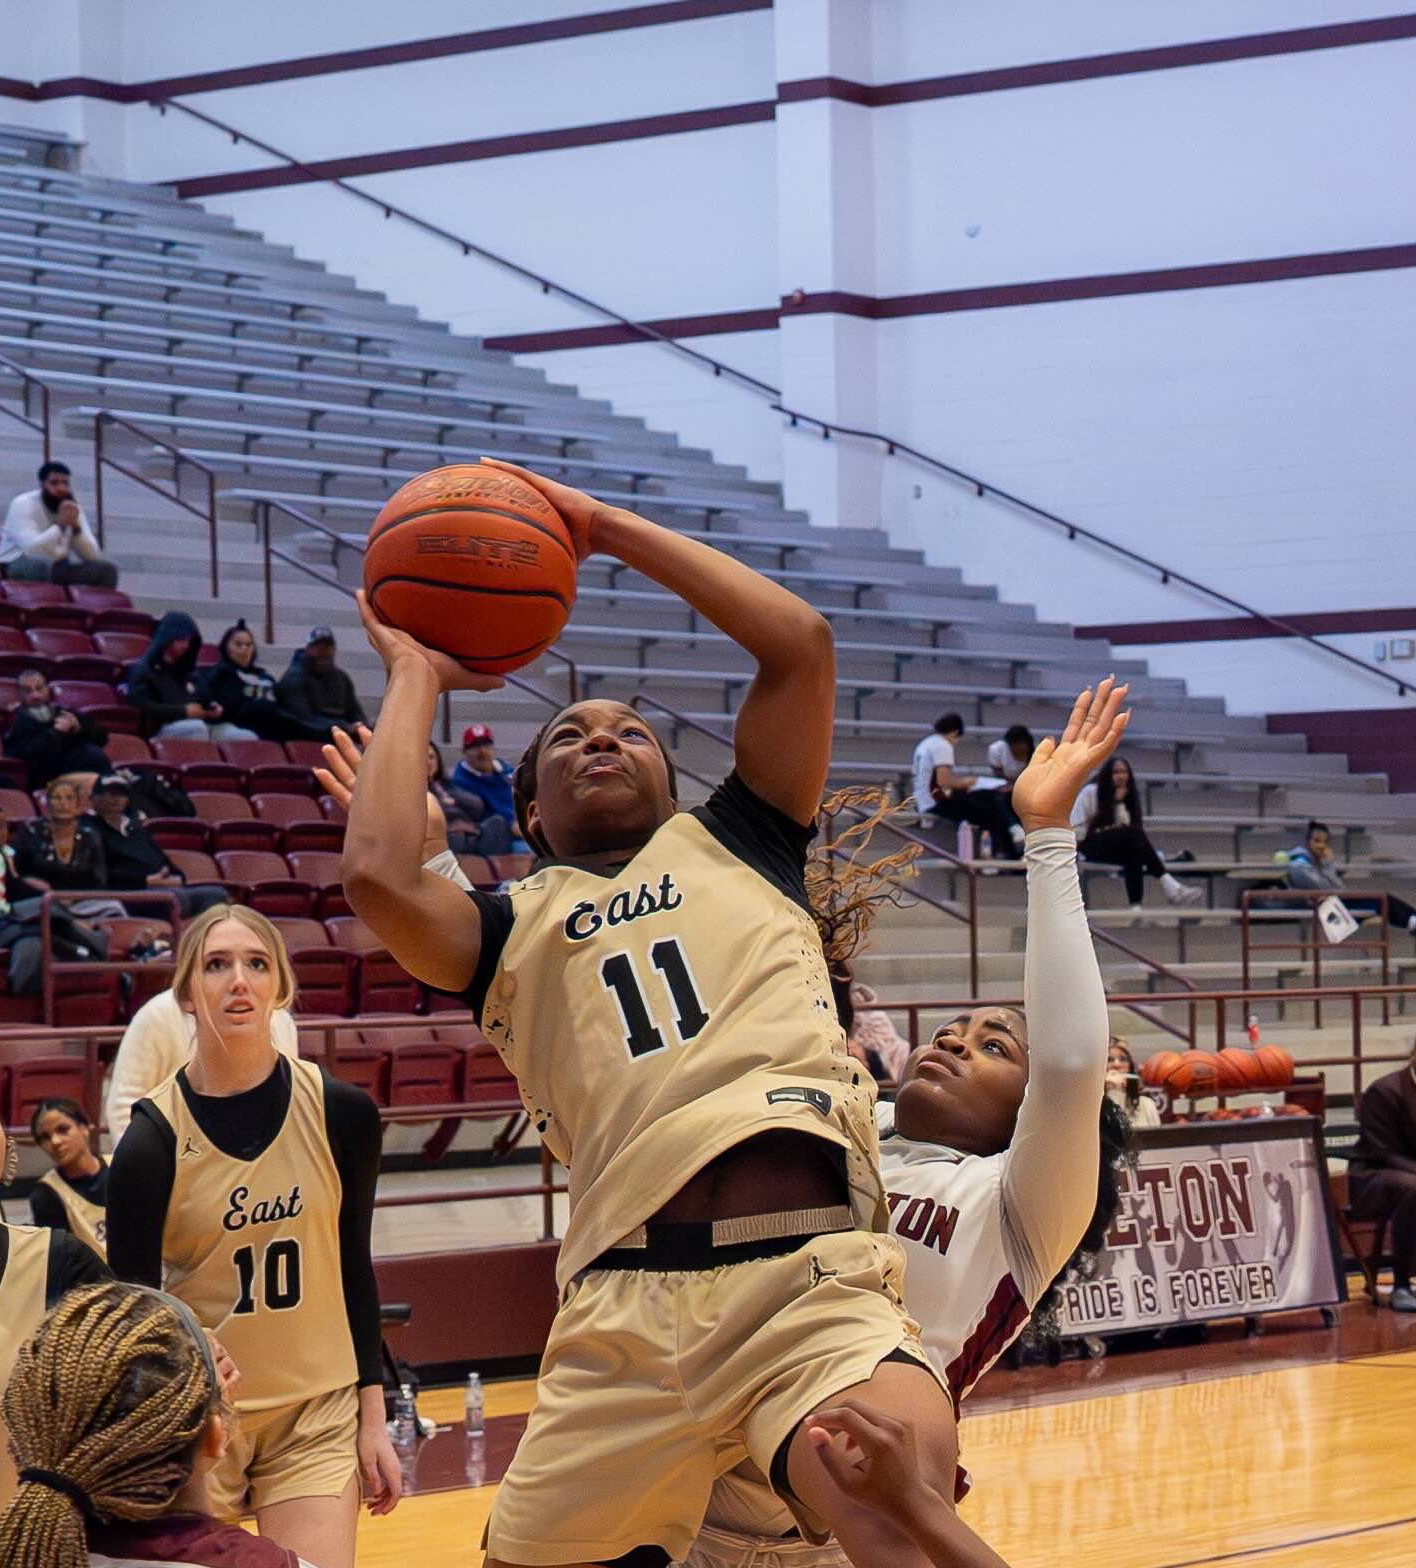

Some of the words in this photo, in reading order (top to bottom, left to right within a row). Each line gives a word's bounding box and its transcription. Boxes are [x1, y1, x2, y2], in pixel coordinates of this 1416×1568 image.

[564, 873, 684, 942] East
[599, 937, 711, 1063] 11
[223, 1185, 303, 1231] East
[233, 1237, 302, 1315] 10
[1065, 1279, 1125, 1325] RIDE
[1133, 1276, 1157, 1314] IS
[1169, 1264, 1278, 1311] FOREVER
